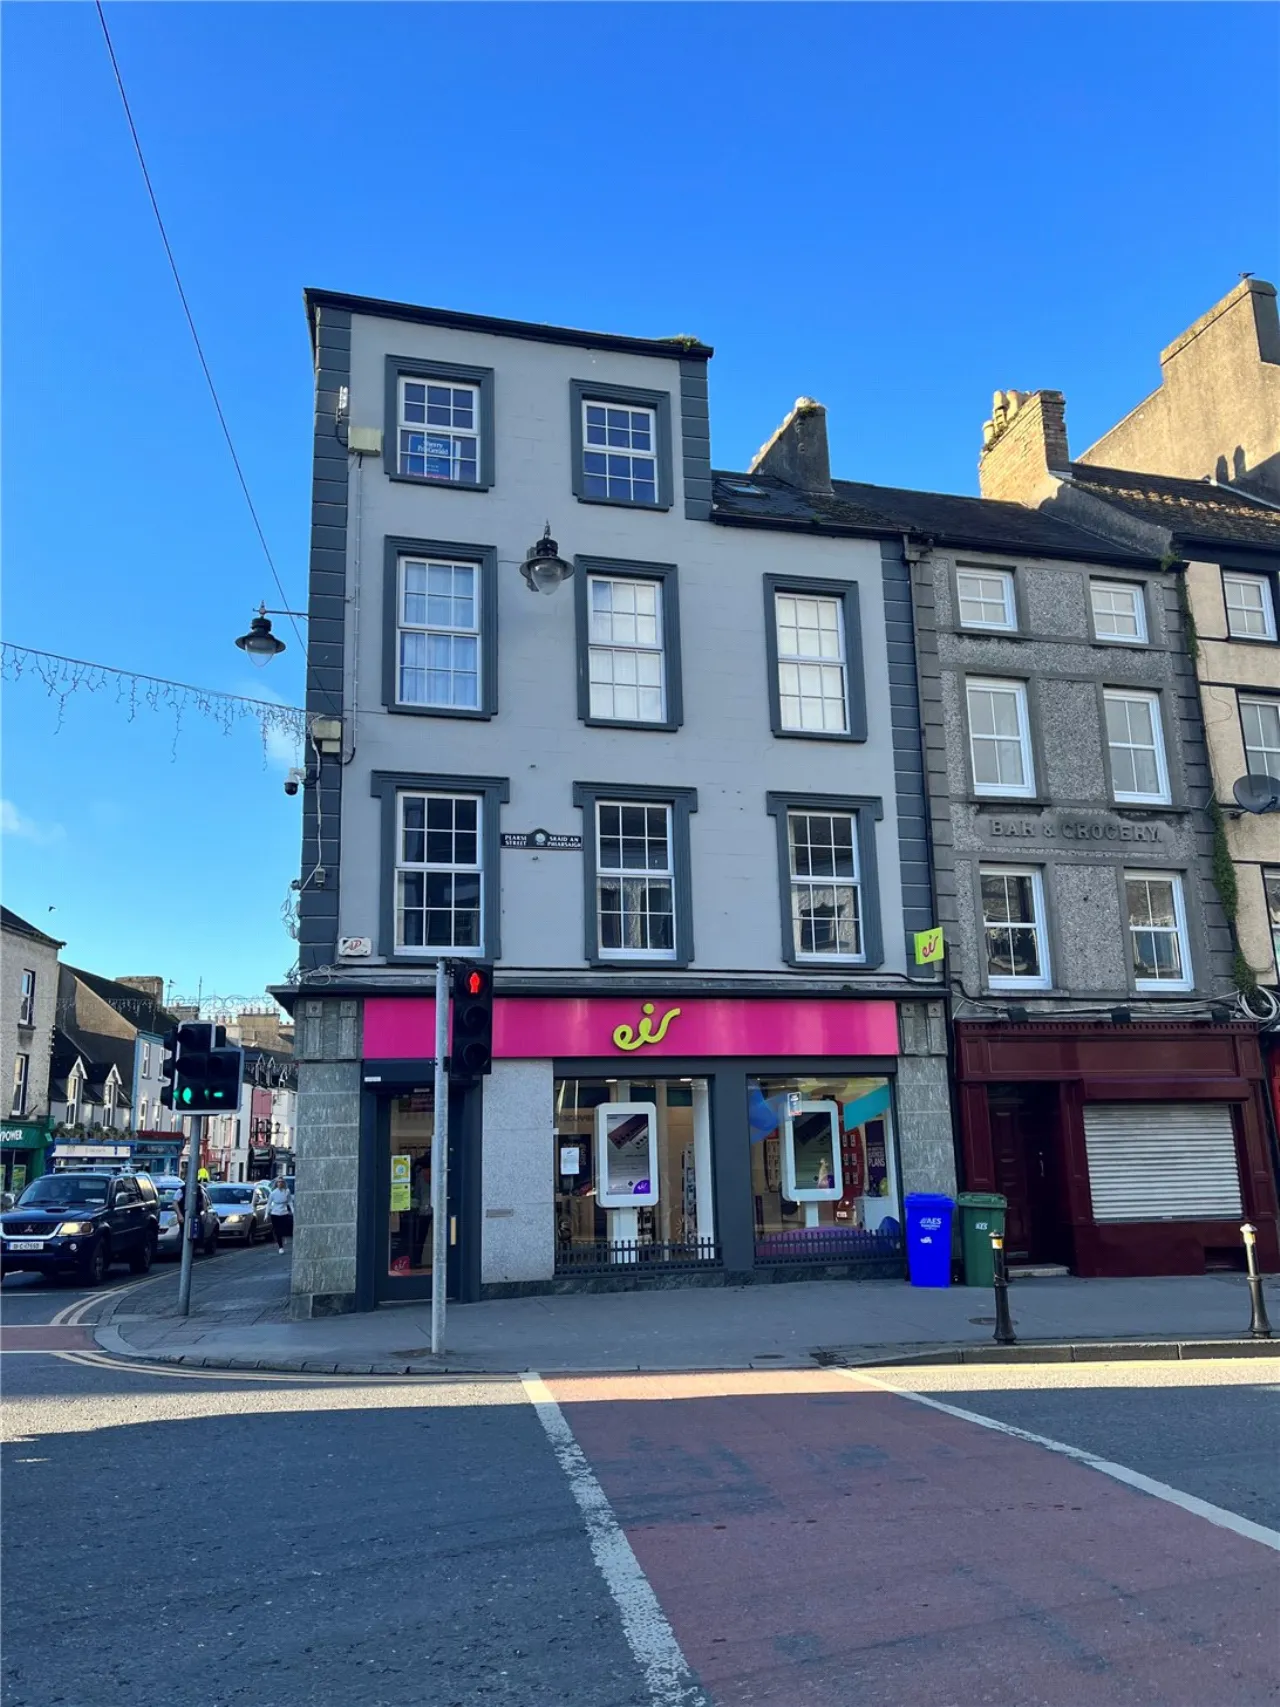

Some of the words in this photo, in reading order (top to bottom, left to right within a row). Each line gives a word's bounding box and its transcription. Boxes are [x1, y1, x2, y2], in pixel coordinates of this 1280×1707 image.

[990, 820, 1036, 838] BAR
[1042, 823, 1056, 838] &
[922, 935, 939, 957] eir
[613, 1003, 681, 1050] eir
